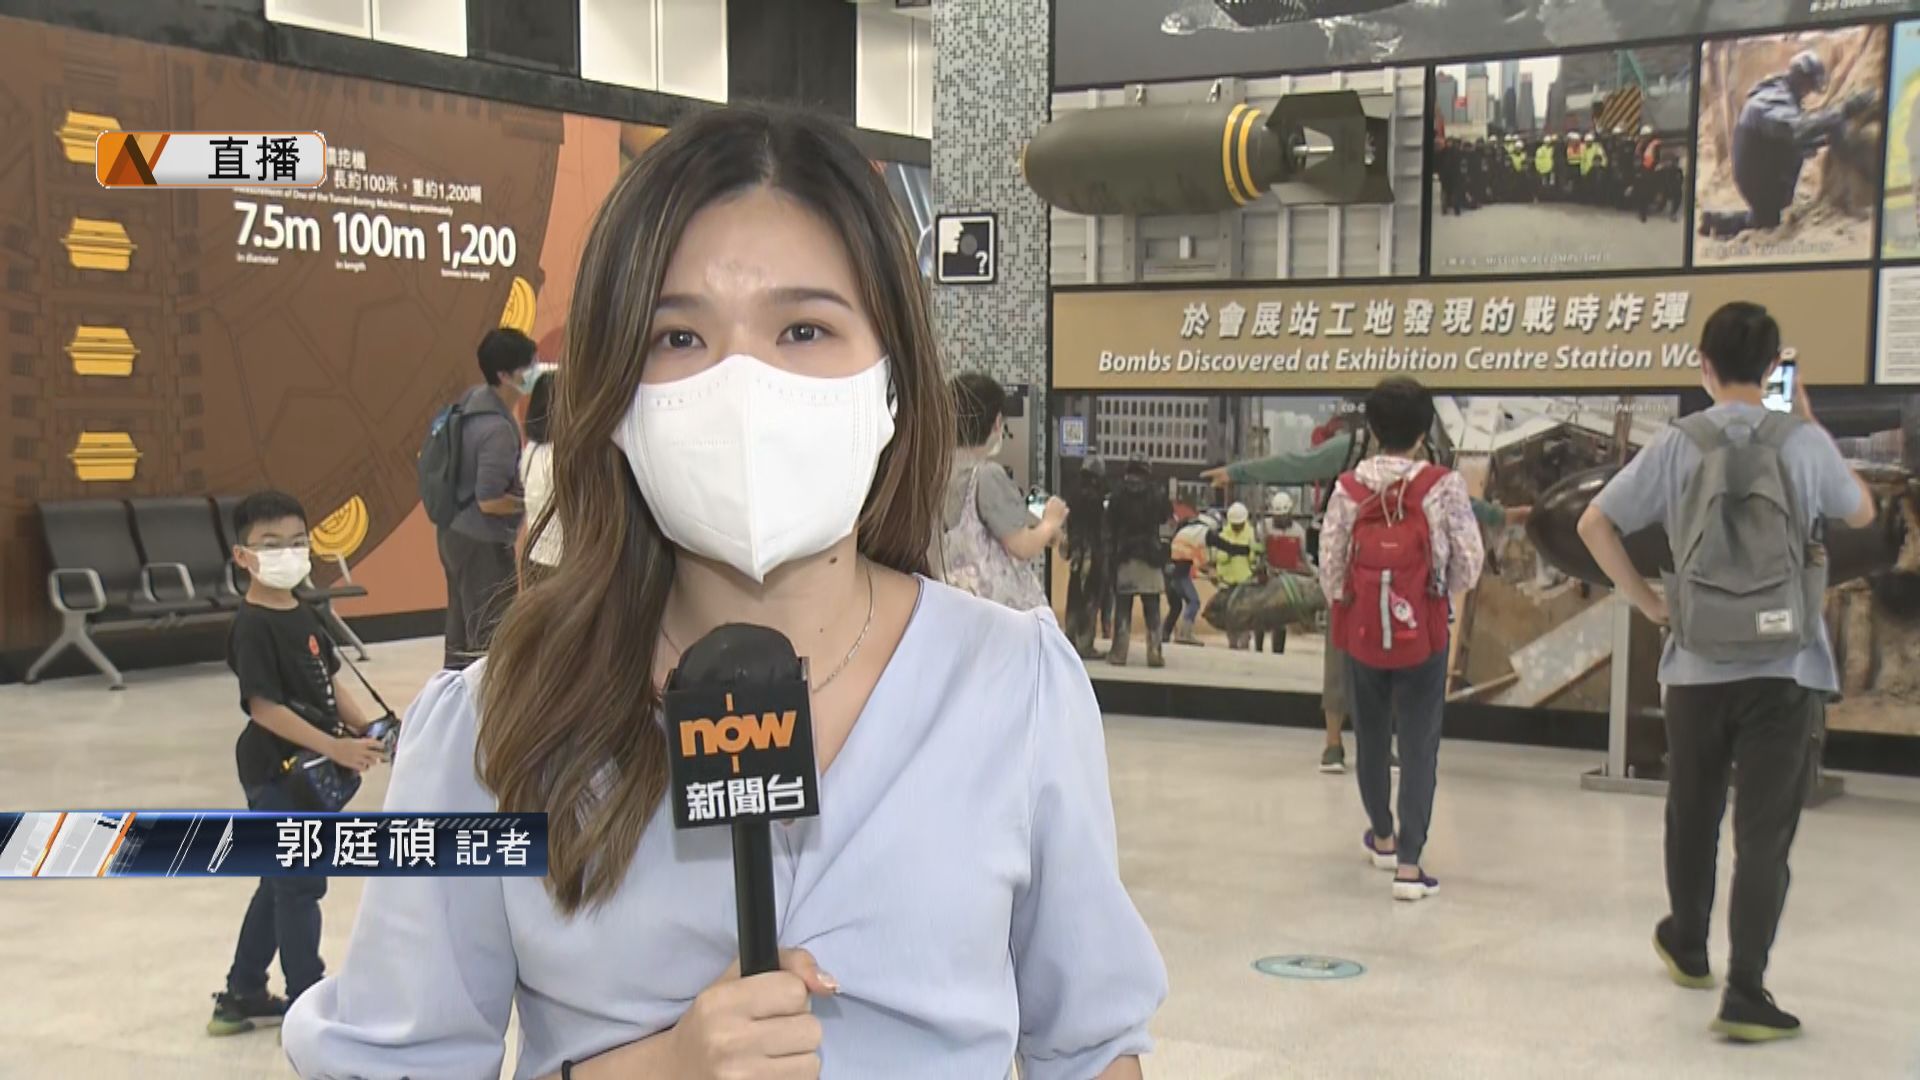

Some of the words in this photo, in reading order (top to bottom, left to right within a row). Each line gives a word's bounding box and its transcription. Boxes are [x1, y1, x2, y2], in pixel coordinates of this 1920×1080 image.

[233, 201, 320, 251] 7.5m
[332, 212, 425, 260] 100m
[437, 222, 516, 269] 1,200
[1181, 291, 1689, 338] 於會展站工地發現的戰時炸彈
[1099, 351, 1171, 372] Bombs
[1177, 349, 1301, 372] Discovered
[1305, 351, 1330, 371] at
[1335, 346, 1457, 371] Exhibition
[1465, 346, 1548, 370] Centre
[1554, 344, 1652, 369] Station
[679, 710, 797, 757] now
[686, 774, 805, 821] 新聞台
